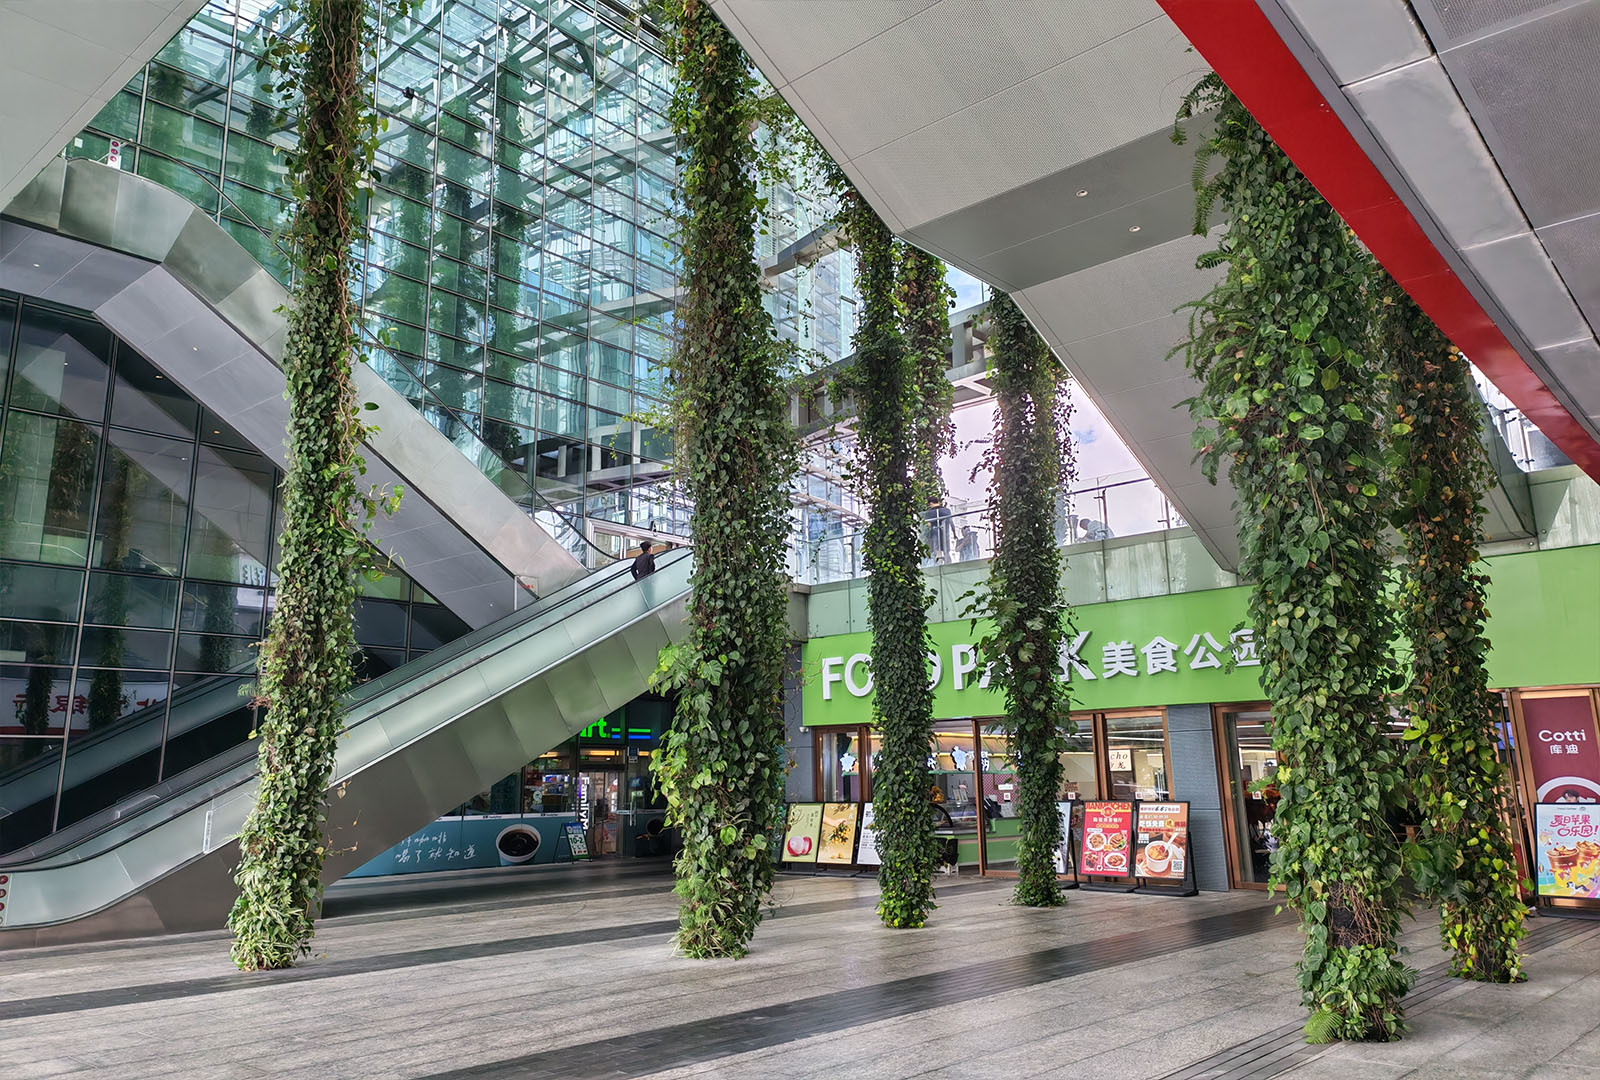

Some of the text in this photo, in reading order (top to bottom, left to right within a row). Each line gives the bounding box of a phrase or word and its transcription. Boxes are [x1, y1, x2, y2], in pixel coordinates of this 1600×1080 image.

[1538, 729, 1586, 742] Cotti
[1550, 744, 1579, 754] 库迪
[1550, 814, 1591, 828] 夏日苹果
